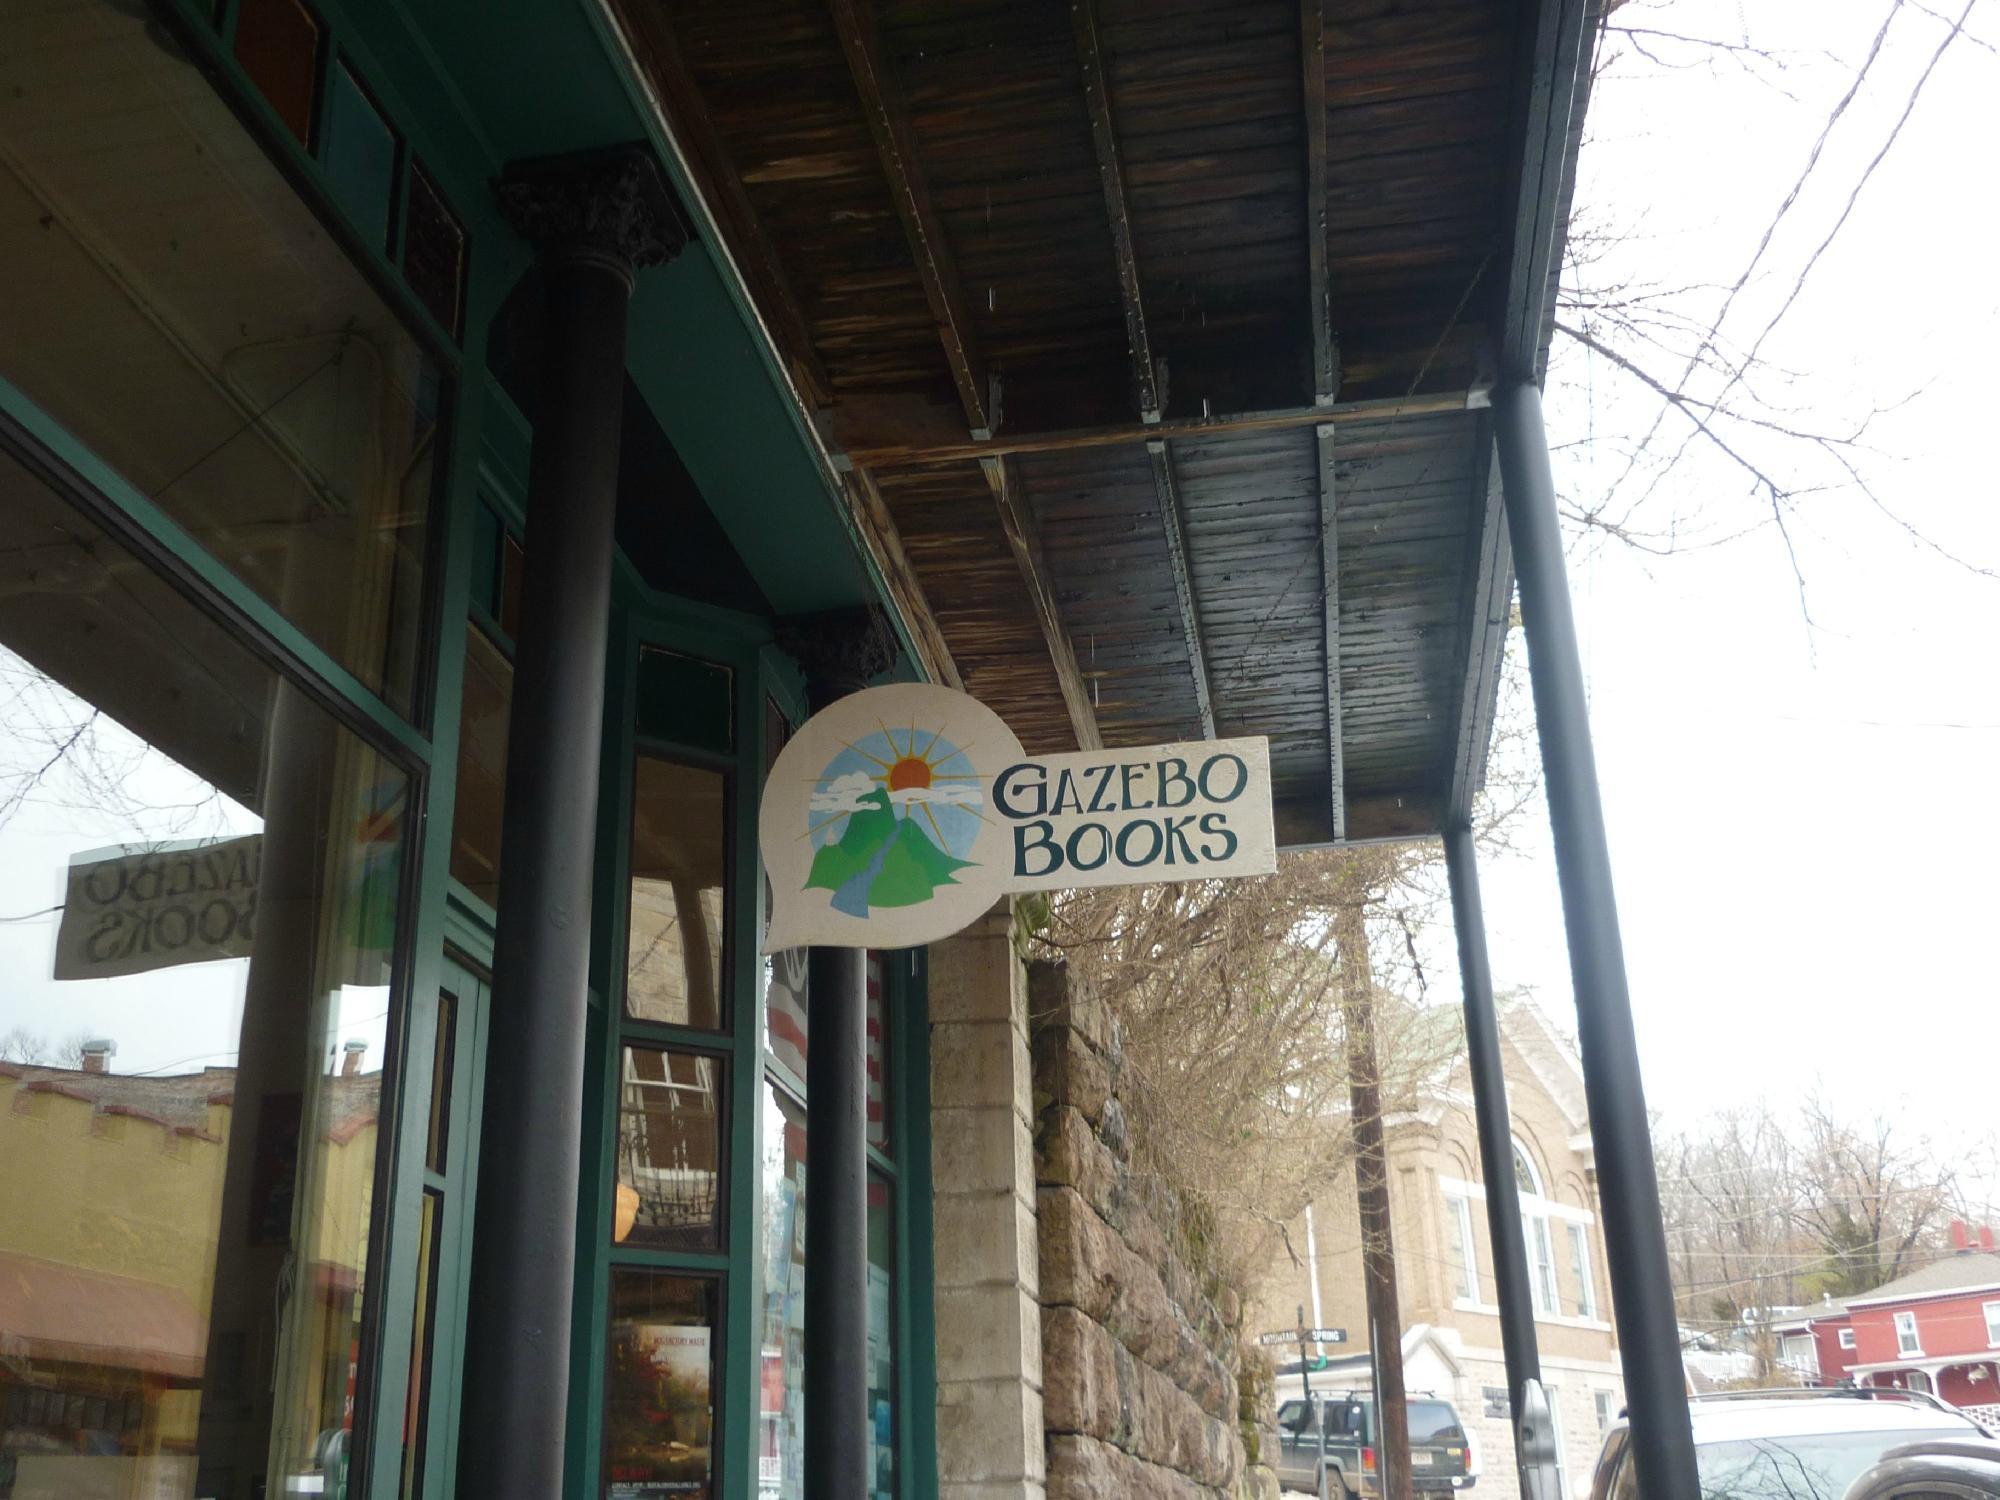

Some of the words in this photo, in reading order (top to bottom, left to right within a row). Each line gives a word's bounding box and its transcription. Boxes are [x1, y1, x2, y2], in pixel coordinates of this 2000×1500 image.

[992, 753, 1248, 819] GAZEBO
[1013, 813, 1238, 877] BOOKS
[1312, 1328, 1340, 1342] SPRING
